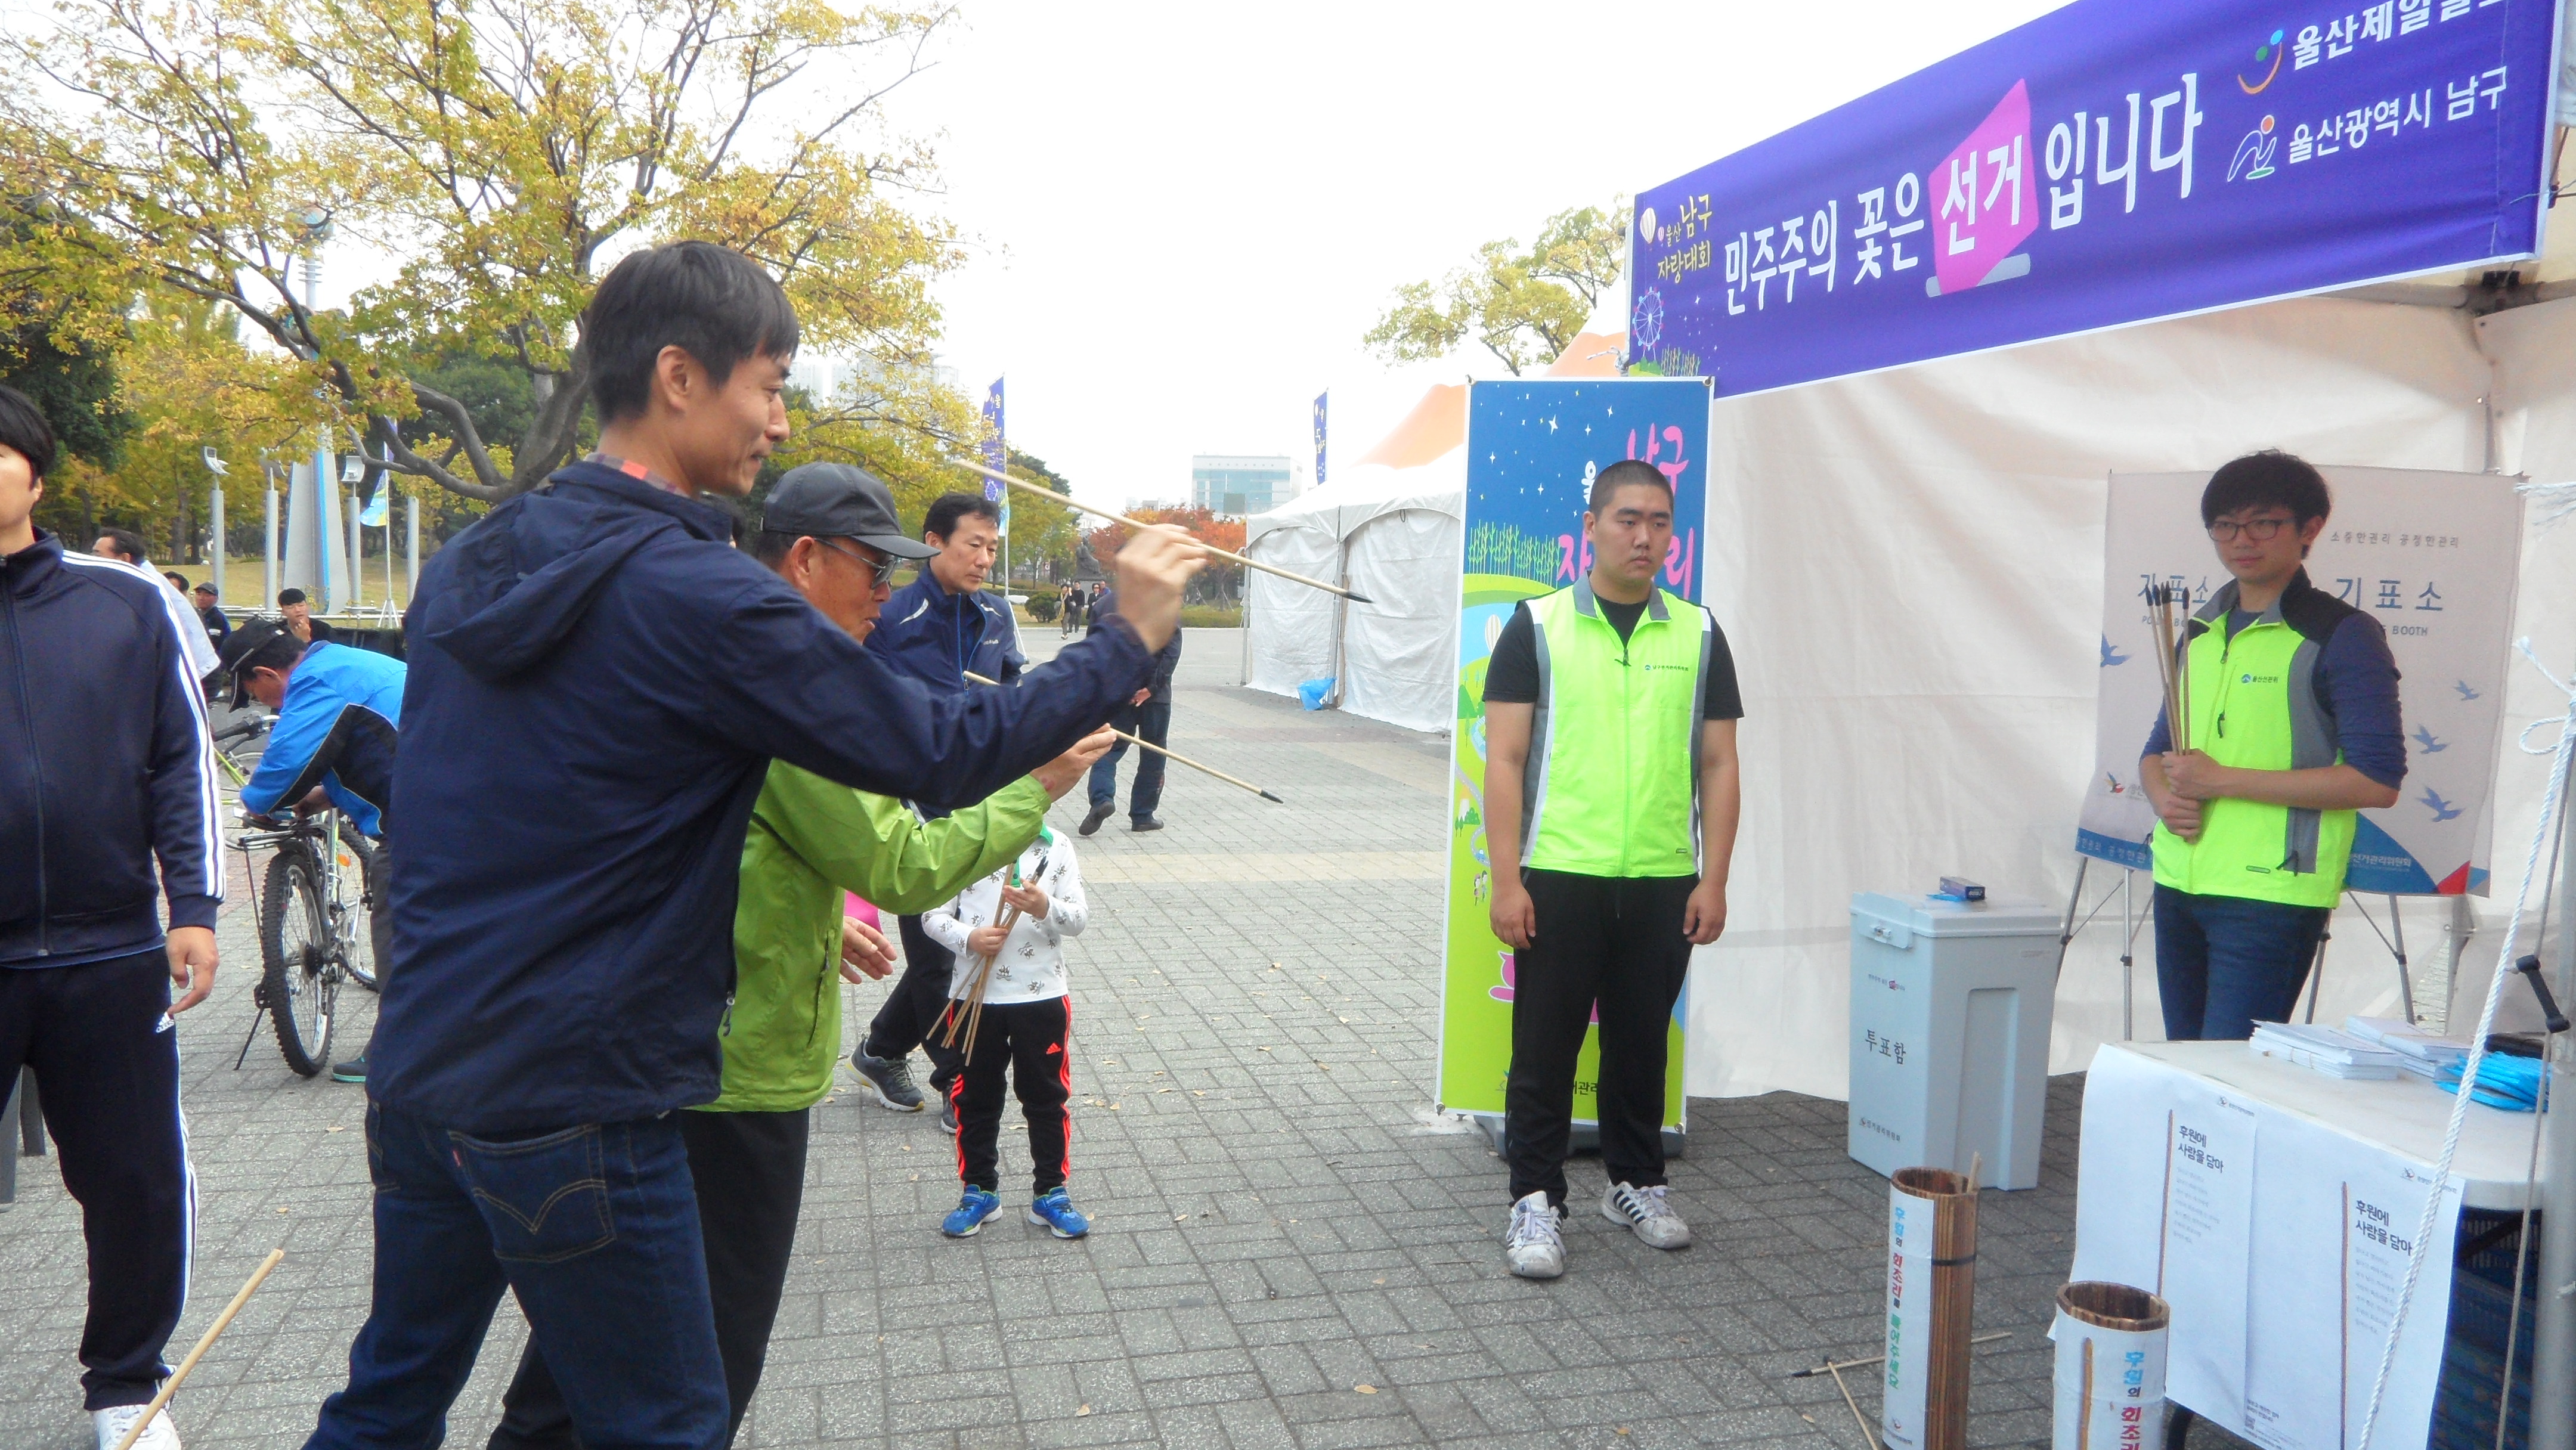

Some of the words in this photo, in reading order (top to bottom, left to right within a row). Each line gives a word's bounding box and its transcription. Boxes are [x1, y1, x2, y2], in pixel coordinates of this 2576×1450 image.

[2289, 89, 2432, 164] 울산광역시
[2447, 66, 2507, 120] 남구
[1724, 199, 1837, 316] 민주주의
[1853, 172, 1924, 286] 꽃은
[1941, 135, 2023, 256] 선거
[2045, 72, 2203, 230] 입니다
[1666, 221, 1682, 247] 울산
[1679, 194, 1712, 238] 남구
[1658, 240, 1710, 284] 자랑대회
[2336, 577, 2444, 612] 기표소
[2392, 625, 2428, 636] BOOTH
[1865, 1029, 1906, 1065] 투표함
[2179, 1124, 2206, 1148] 후원에
[2178, 1143, 2205, 1165] 사랑을
[2206, 1154, 2224, 1173] 담아
[2356, 1200, 2389, 1227] 후원에
[2356, 1220, 2388, 1246] 사랑을
[2390, 1234, 2412, 1256] 담아
